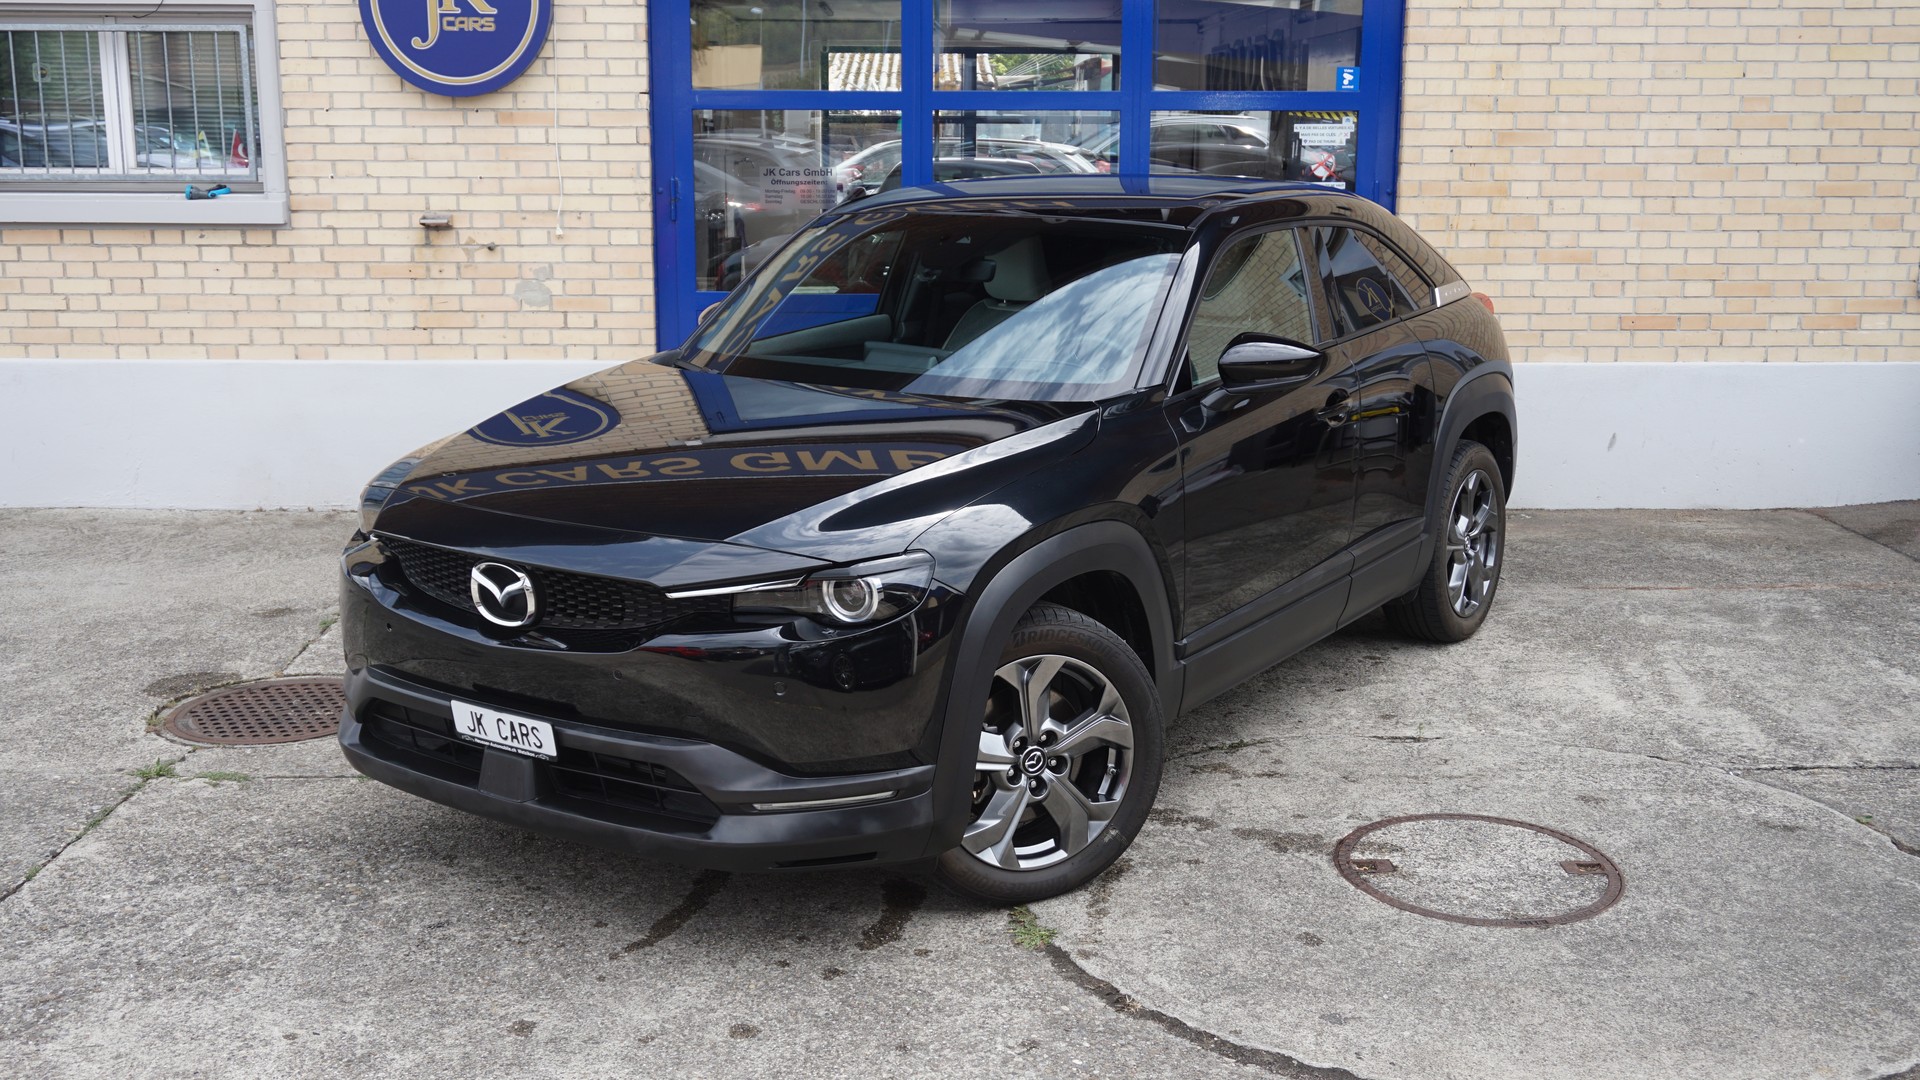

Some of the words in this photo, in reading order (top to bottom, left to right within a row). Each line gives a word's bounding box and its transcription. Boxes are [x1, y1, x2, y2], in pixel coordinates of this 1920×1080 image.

[442, 16, 496, 32] CARS
[763, 168, 776, 177] JK
[779, 168, 800, 177] Cars
[803, 168, 833, 177] GmbH
[771, 179, 828, 187] Öffnungszeiten:
[467, 711, 488, 737] JK
[496, 718, 543, 749] CARS
